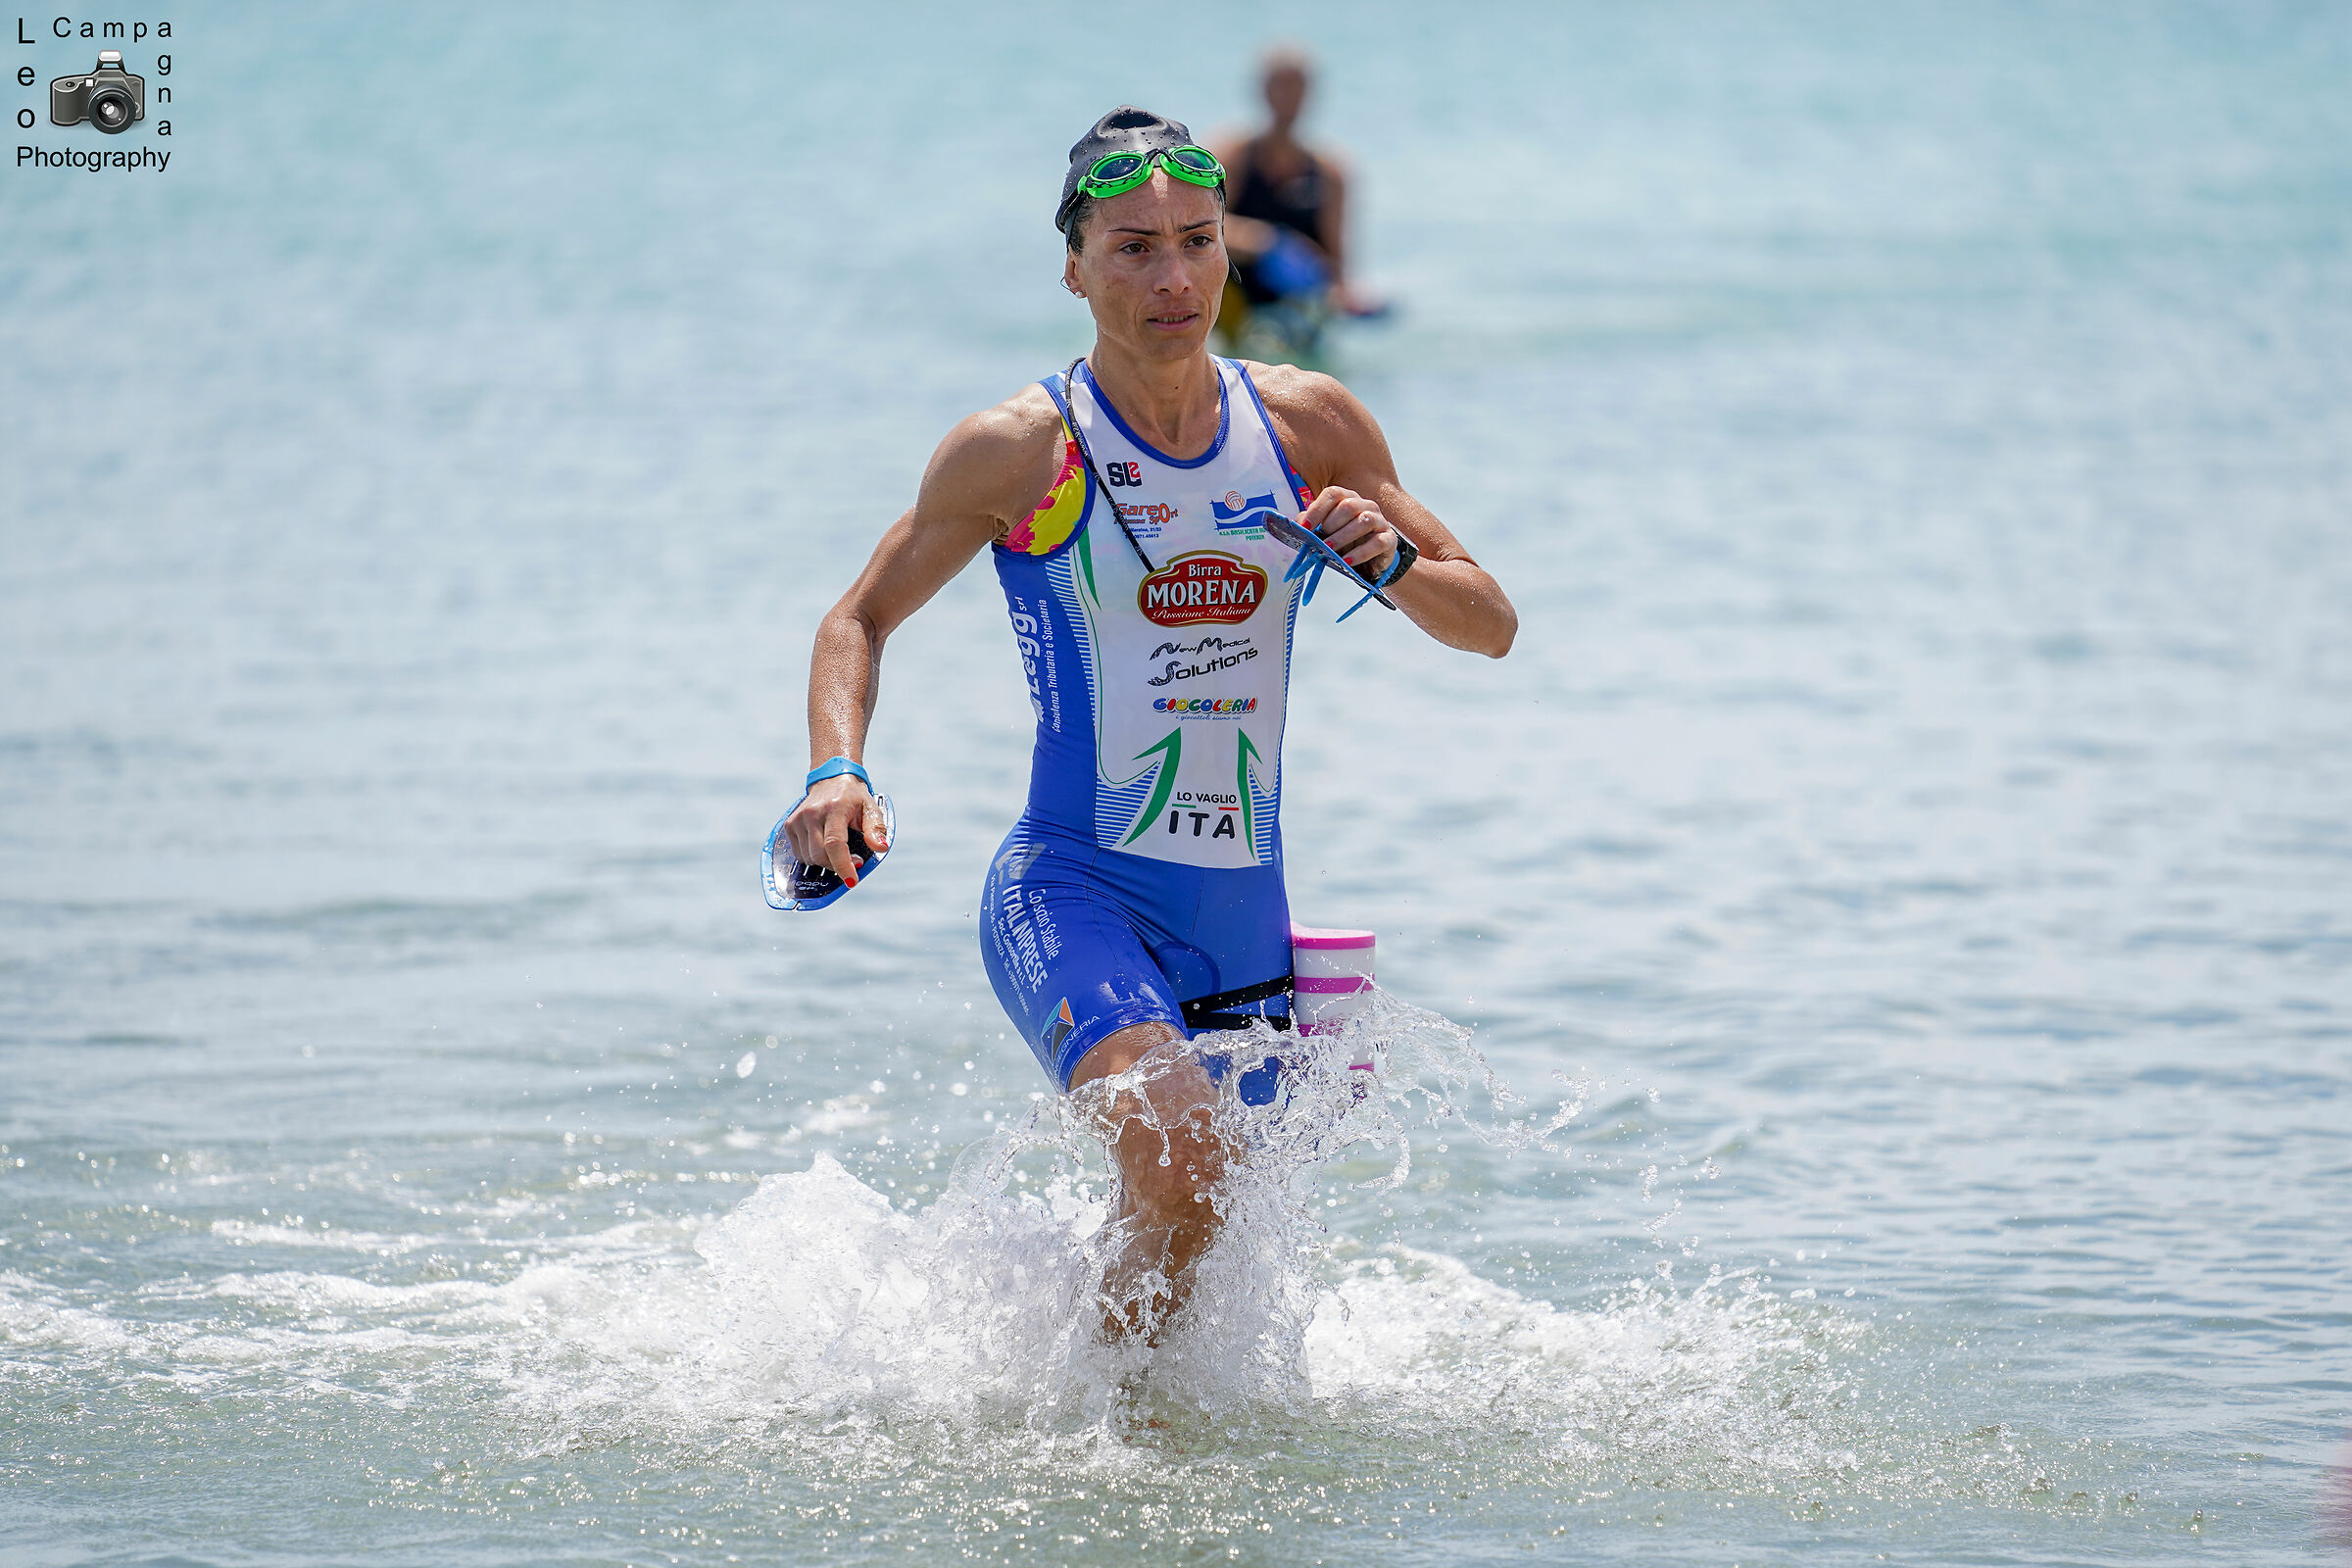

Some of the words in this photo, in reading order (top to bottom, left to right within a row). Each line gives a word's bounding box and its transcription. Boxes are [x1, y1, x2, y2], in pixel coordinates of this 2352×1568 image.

[1189, 564, 1222, 577] Birra
[1147, 580, 1255, 609] MORENA
[1038, 599, 1054, 641] Societaria
[1152, 609, 1205, 620] Passione
[1206, 606, 1251, 617] Italiana
[1149, 642, 1197, 661] New
[1196, 637, 1250, 656] Medical
[1044, 649, 1058, 688] Tributaria
[1147, 647, 1258, 687] Solutions
[1152, 697, 1258, 714] GIOCOLERIA
[1177, 791, 1192, 802] LO
[1196, 793, 1237, 804] VAGLIO
[1168, 809, 1236, 840] ITA
[992, 926, 1005, 958] POTENZA
[1040, 923, 1062, 960] Stabile
